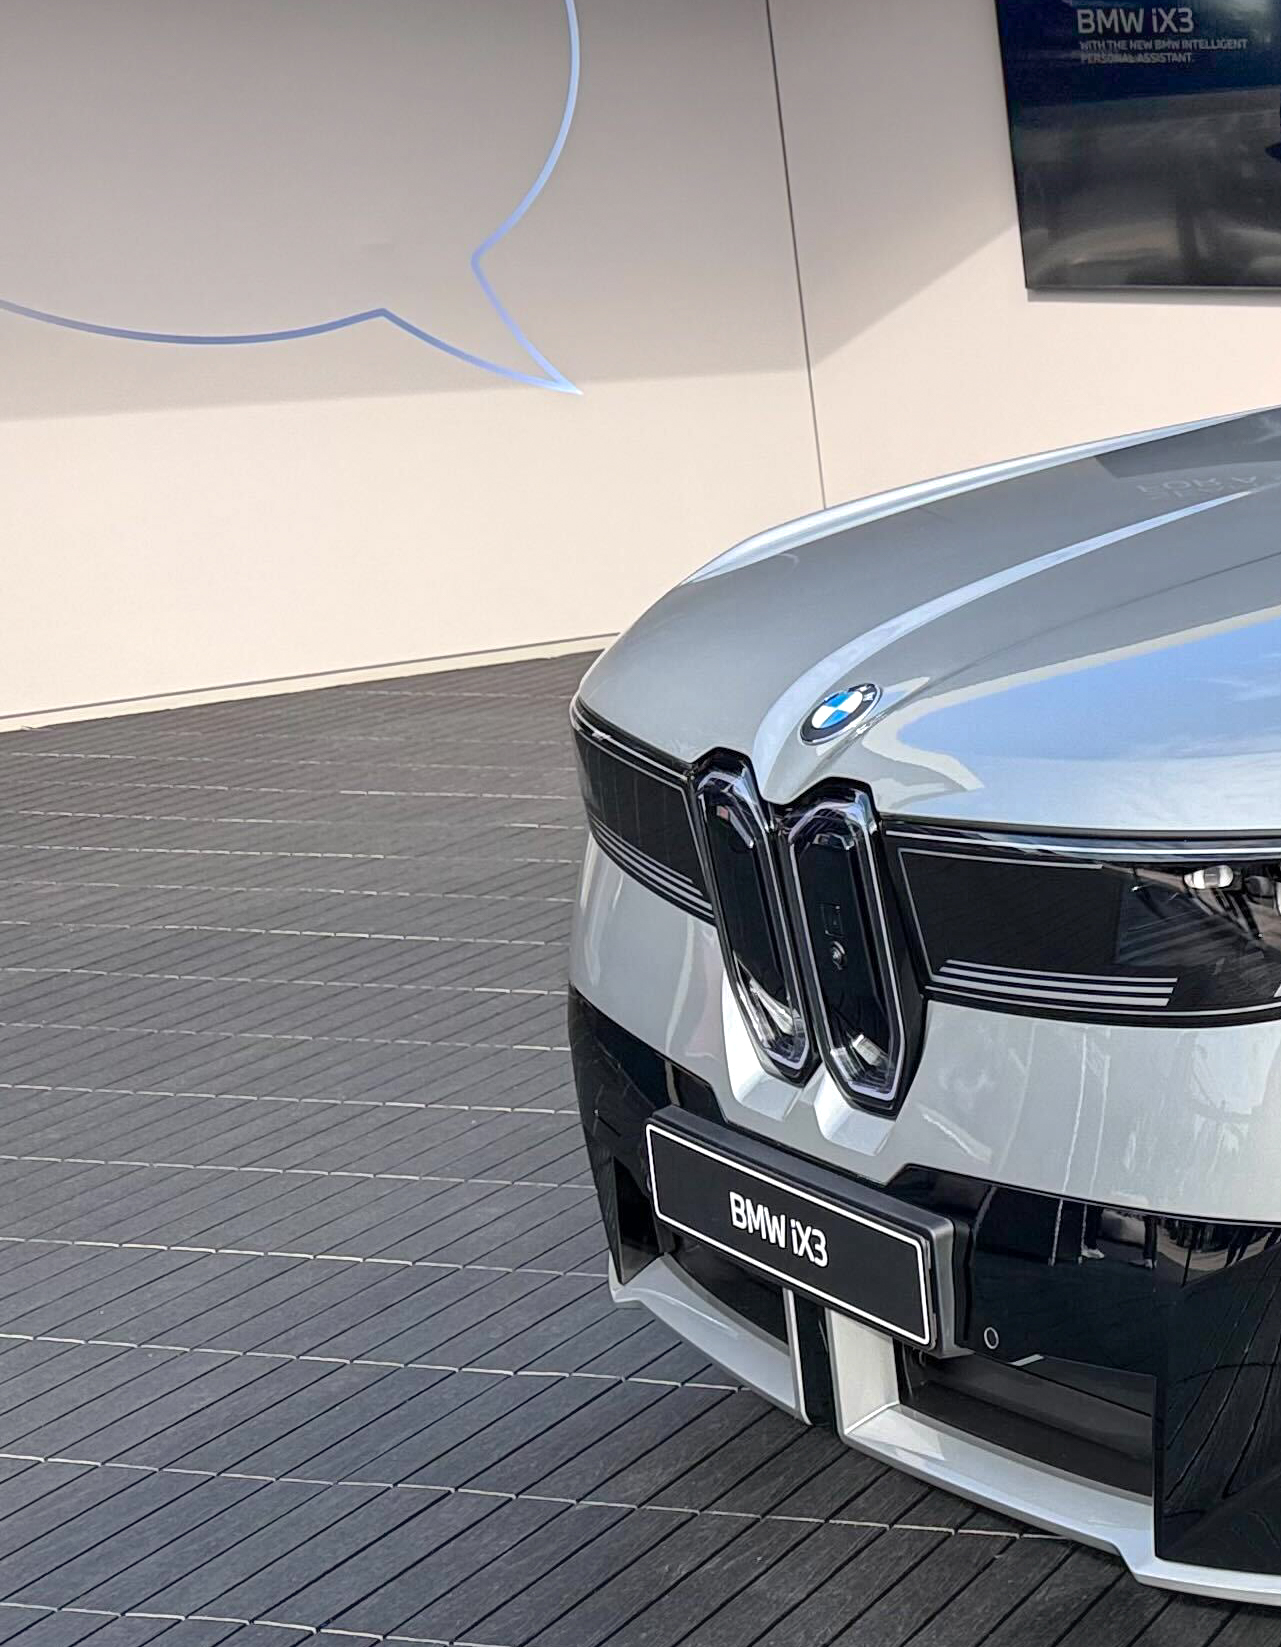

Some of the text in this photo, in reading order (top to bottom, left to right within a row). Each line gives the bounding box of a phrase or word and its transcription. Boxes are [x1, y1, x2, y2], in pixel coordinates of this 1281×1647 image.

[1076, 7, 1195, 33] BMW iX3
[1080, 38, 1249, 50] WITH THE NEW BMW INTELLIGENT
[729, 1191, 829, 1268] BMW iX3
